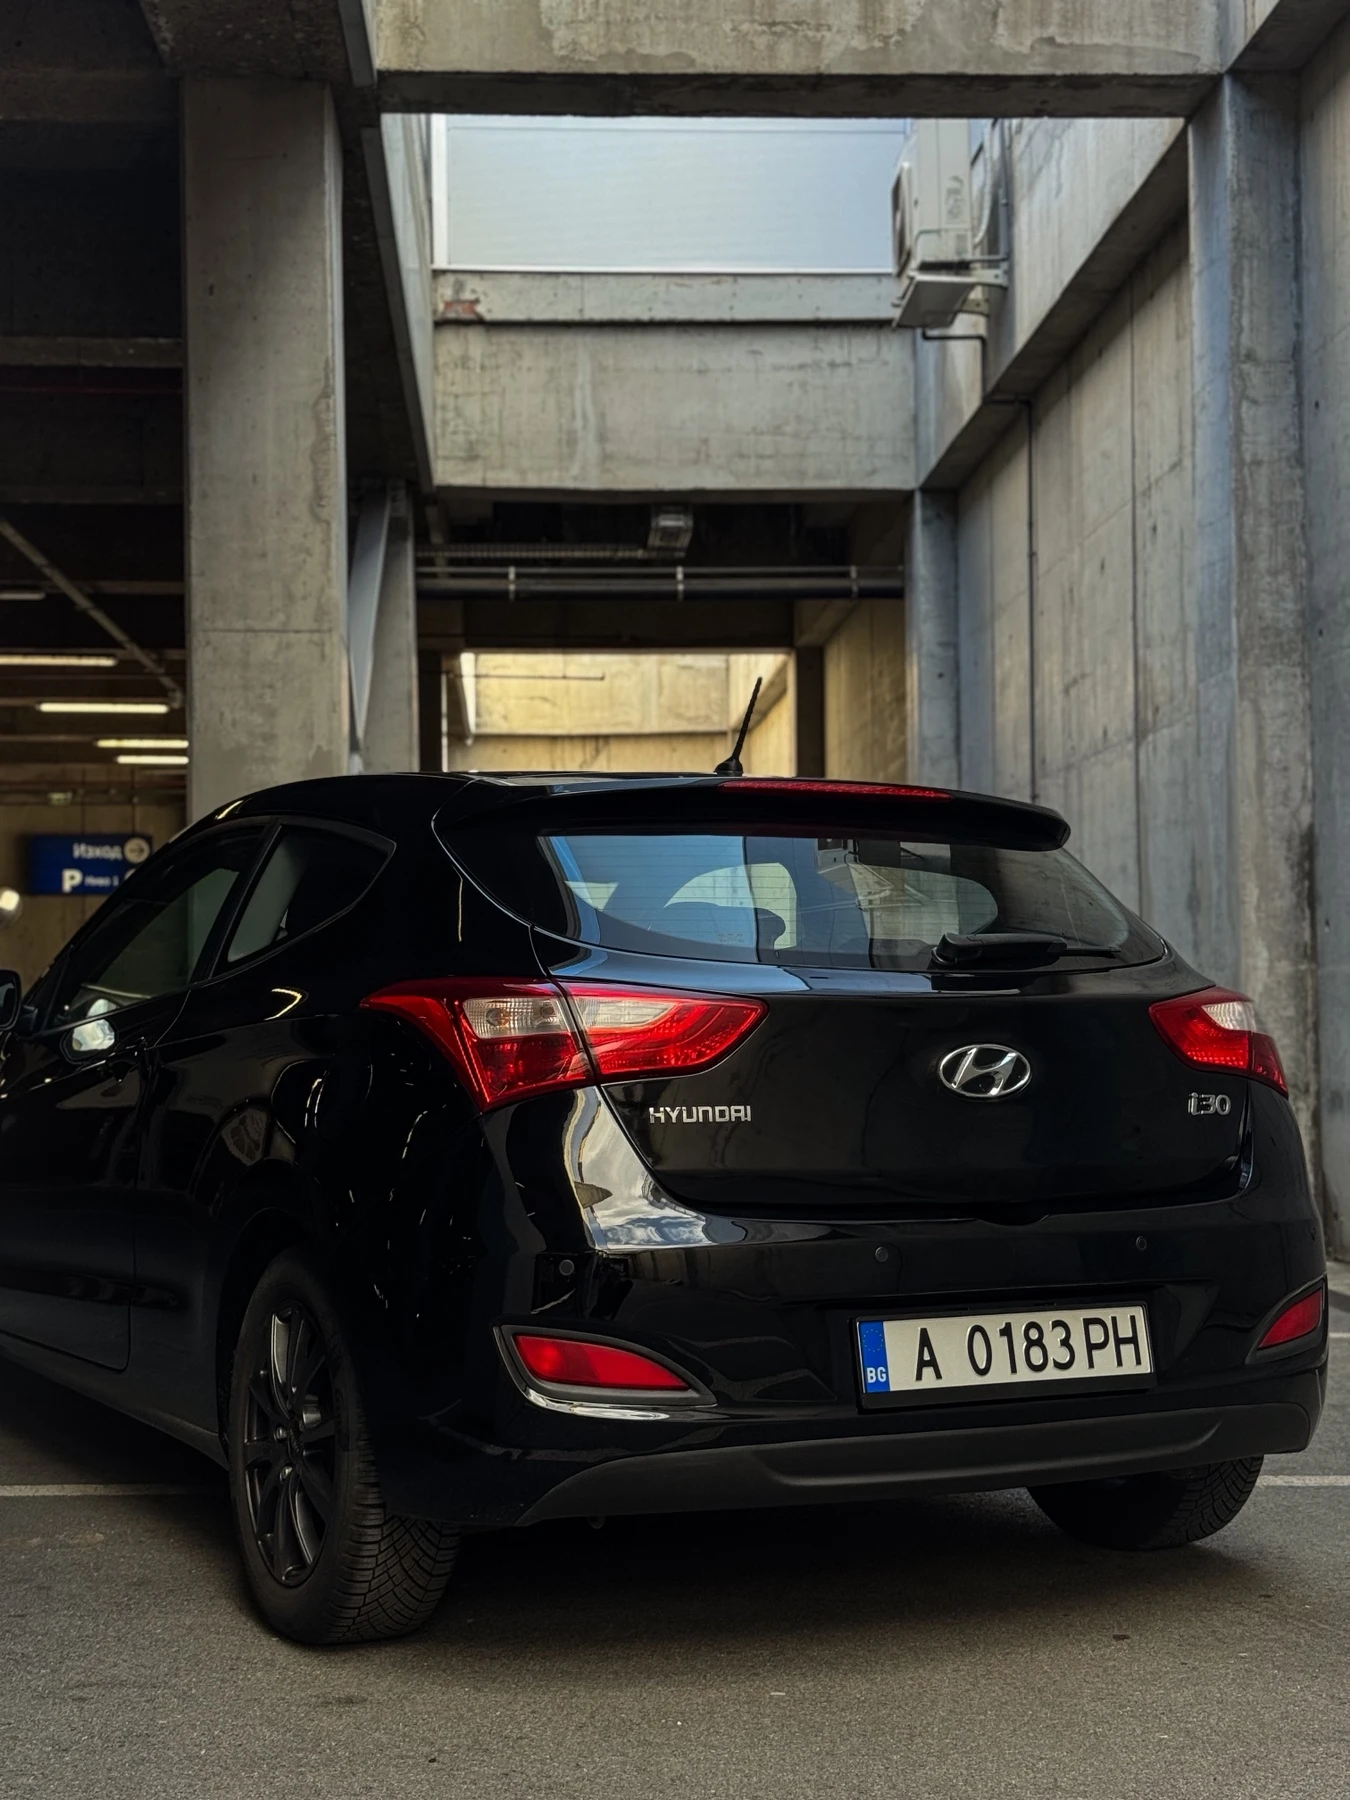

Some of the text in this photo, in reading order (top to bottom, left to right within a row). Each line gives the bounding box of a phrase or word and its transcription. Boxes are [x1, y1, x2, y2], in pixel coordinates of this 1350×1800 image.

[61, 868, 83, 893] P
[649, 1105, 752, 1124] HYUNDAI
[1188, 1092, 1232, 1116] i30
[915, 1327, 943, 1382] A
[866, 1366, 887, 1384] BG
